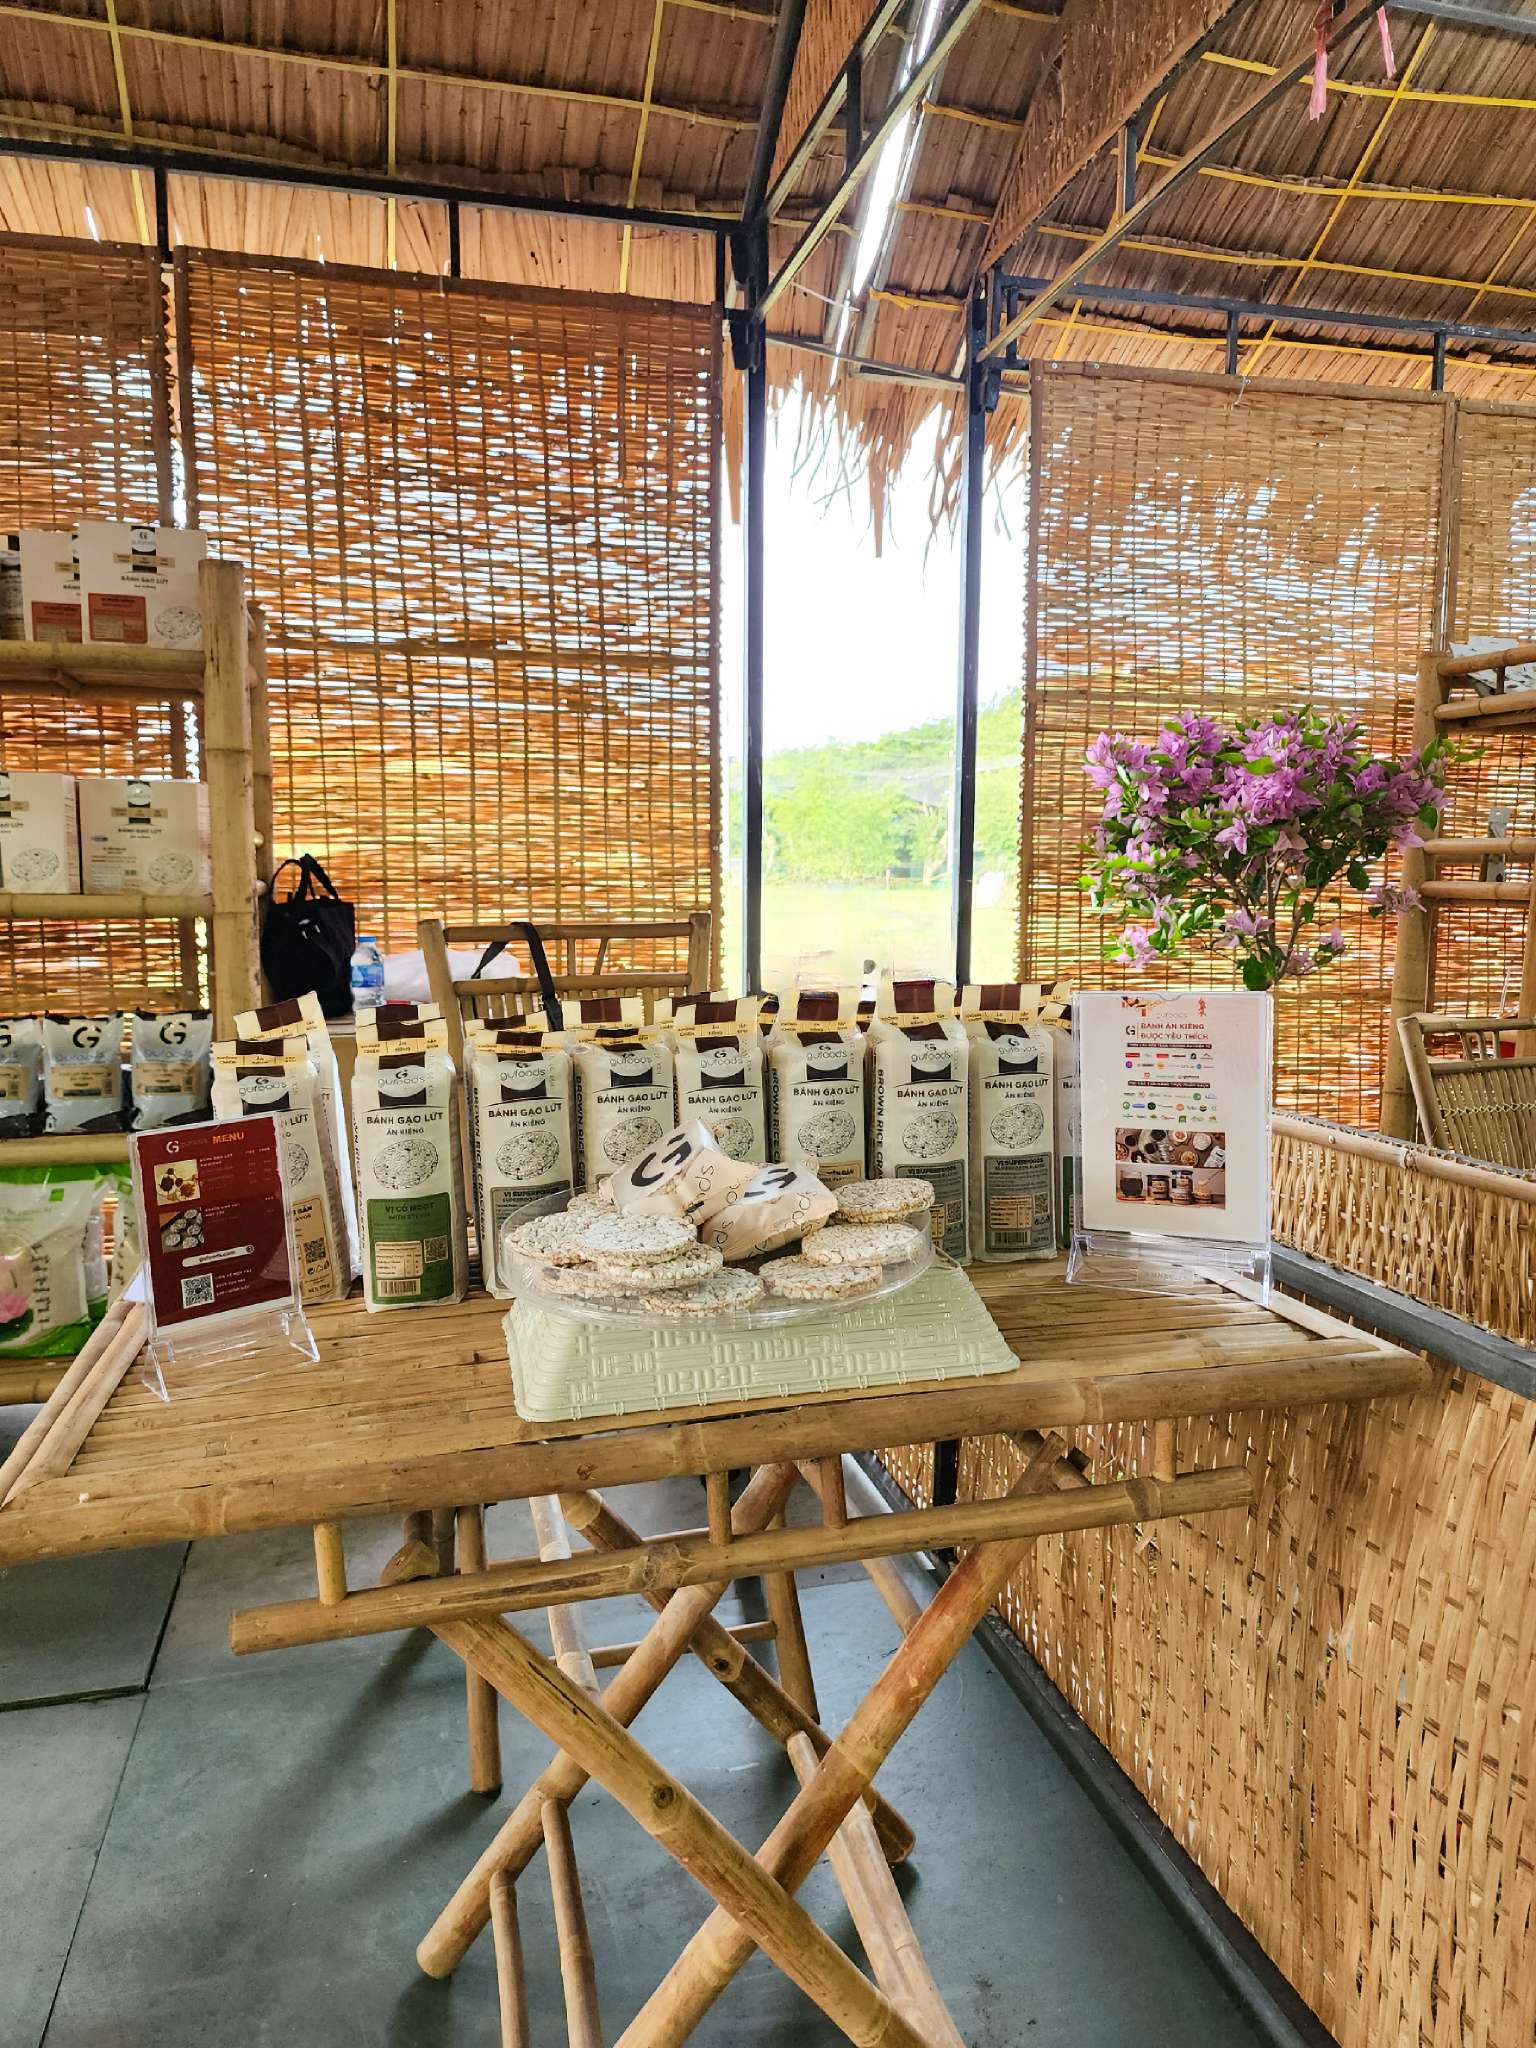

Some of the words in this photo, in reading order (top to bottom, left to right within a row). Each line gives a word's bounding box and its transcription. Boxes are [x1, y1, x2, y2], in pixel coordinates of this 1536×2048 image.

[72, 1026, 102, 1048] G
[160, 1022, 187, 1045] G
[499, 1068, 546, 1081] gufoods
[239, 1082, 288, 1097] gufoods
[793, 1087, 820, 1097] BÁNH
[822, 1087, 844, 1097] GẠO
[845, 1085, 860, 1095] LỨT
[985, 1080, 1013, 1089] BÁNH
[1015, 1080, 1034, 1090] GẠO
[1034, 1078, 1049, 1087] LỨT
[597, 1094, 625, 1104] BÁNH
[627, 1093, 649, 1103] GẠO
[650, 1090, 668, 1100] LỨT
[688, 1094, 716, 1104] BÁNH
[718, 1095, 740, 1105] GẠO
[741, 1090, 758, 1100] LỨT
[897, 1088, 925, 1098] BÁNH
[927, 1088, 948, 1098] GẠO
[488, 1108, 518, 1118] BÁNH
[520, 1107, 543, 1118] GẠO
[544, 1102, 563, 1113] LỨT
[289, 1113, 309, 1126] LỨT
[366, 1115, 394, 1125] BÁNH
[397, 1115, 422, 1126] GẠO
[424, 1111, 444, 1122] LỨT
[212, 1131, 245, 1145] MENU
[385, 1206, 394, 1214] VỊ
